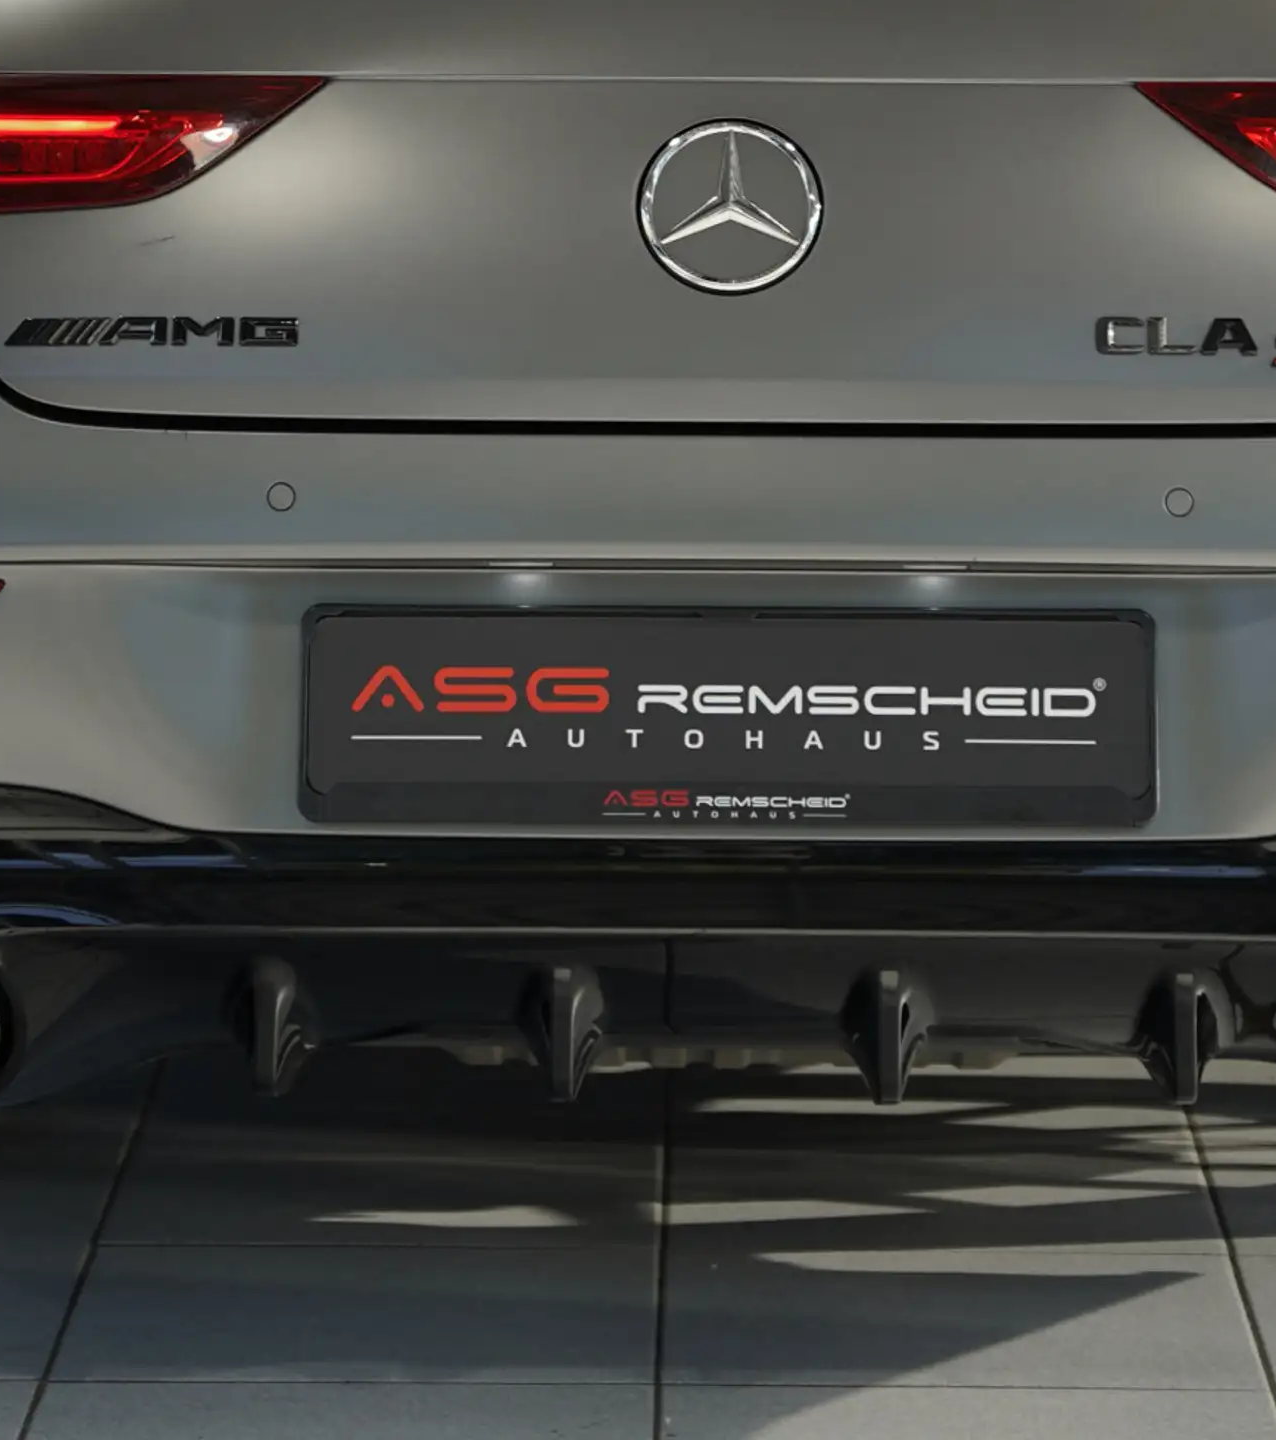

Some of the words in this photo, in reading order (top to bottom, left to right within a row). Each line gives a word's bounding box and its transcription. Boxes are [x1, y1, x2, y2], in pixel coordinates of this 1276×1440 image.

[99, 315, 299, 347] AMG
[1095, 316, 1258, 356] CLA
[351, 665, 610, 713] ASG
[506, 728, 940, 751] AUTOHAUS
[604, 789, 690, 808] ASG
